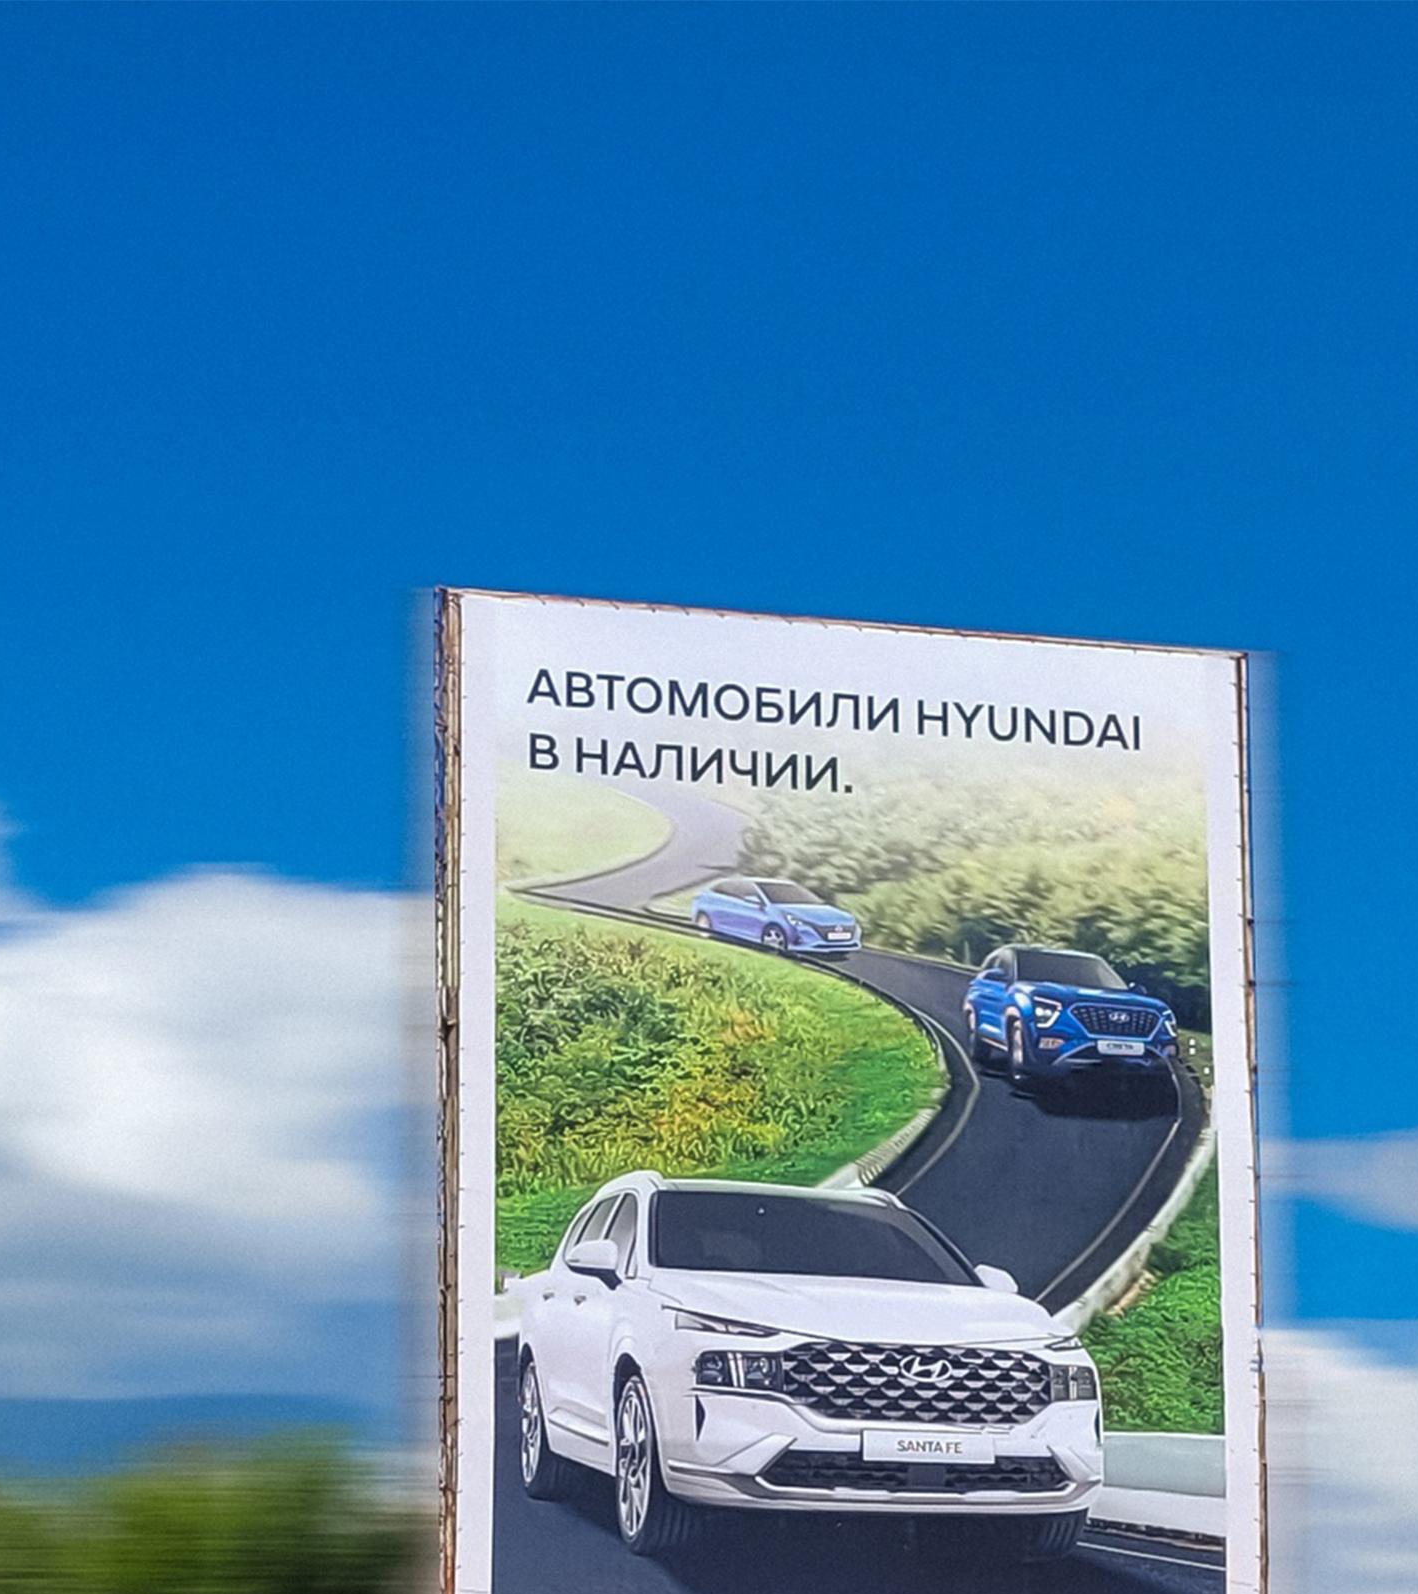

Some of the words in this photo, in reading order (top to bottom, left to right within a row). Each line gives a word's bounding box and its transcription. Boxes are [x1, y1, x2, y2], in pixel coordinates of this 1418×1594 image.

[527, 669, 900, 734] АВТОМОБИЛИ
[918, 699, 1141, 751] HYUNDAI
[529, 732, 559, 771] В
[576, 736, 853, 794] НАЛИЧИИ.
[897, 1439, 944, 1454] SANTA
[945, 1441, 963, 1454] FE
